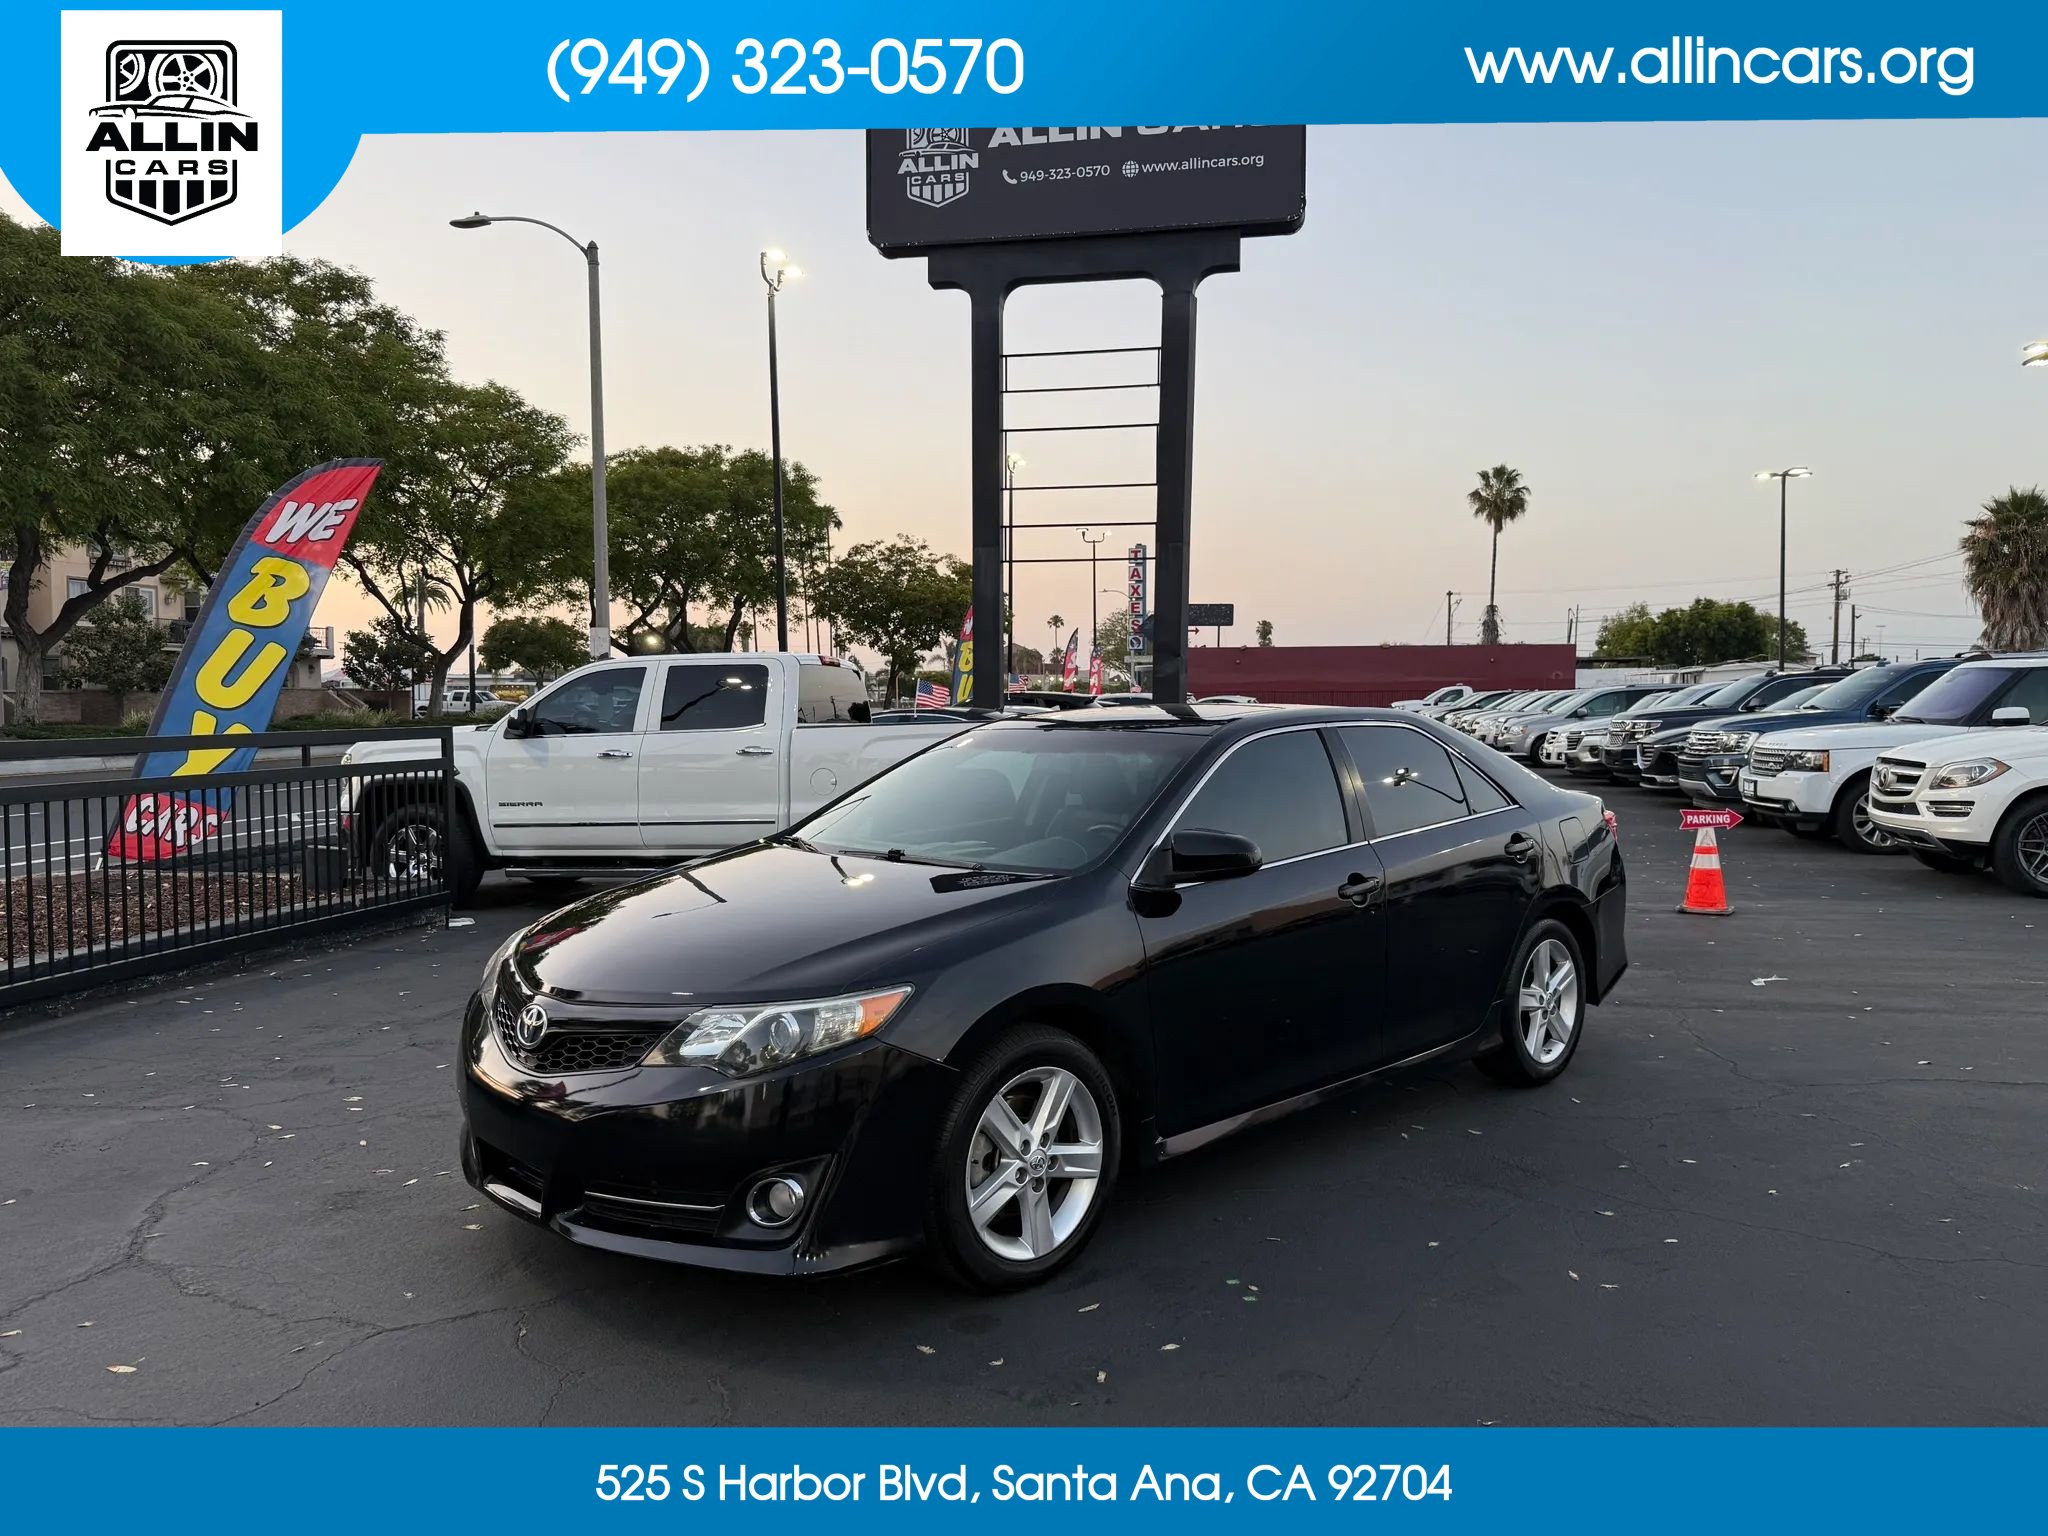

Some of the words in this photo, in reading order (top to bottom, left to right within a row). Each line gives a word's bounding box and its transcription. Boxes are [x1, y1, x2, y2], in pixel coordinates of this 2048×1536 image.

[897, 152, 979, 175] ALLIN
[1019, 164, 1111, 183] 949-323-0570
[1141, 153, 1265, 174] www.allincars.org
[911, 172, 965, 185] CARS
[265, 497, 359, 544] WE
[1130, 550, 1142, 635] TAXES
[172, 556, 311, 777] BUY
[1686, 814, 1731, 825] PARKING
